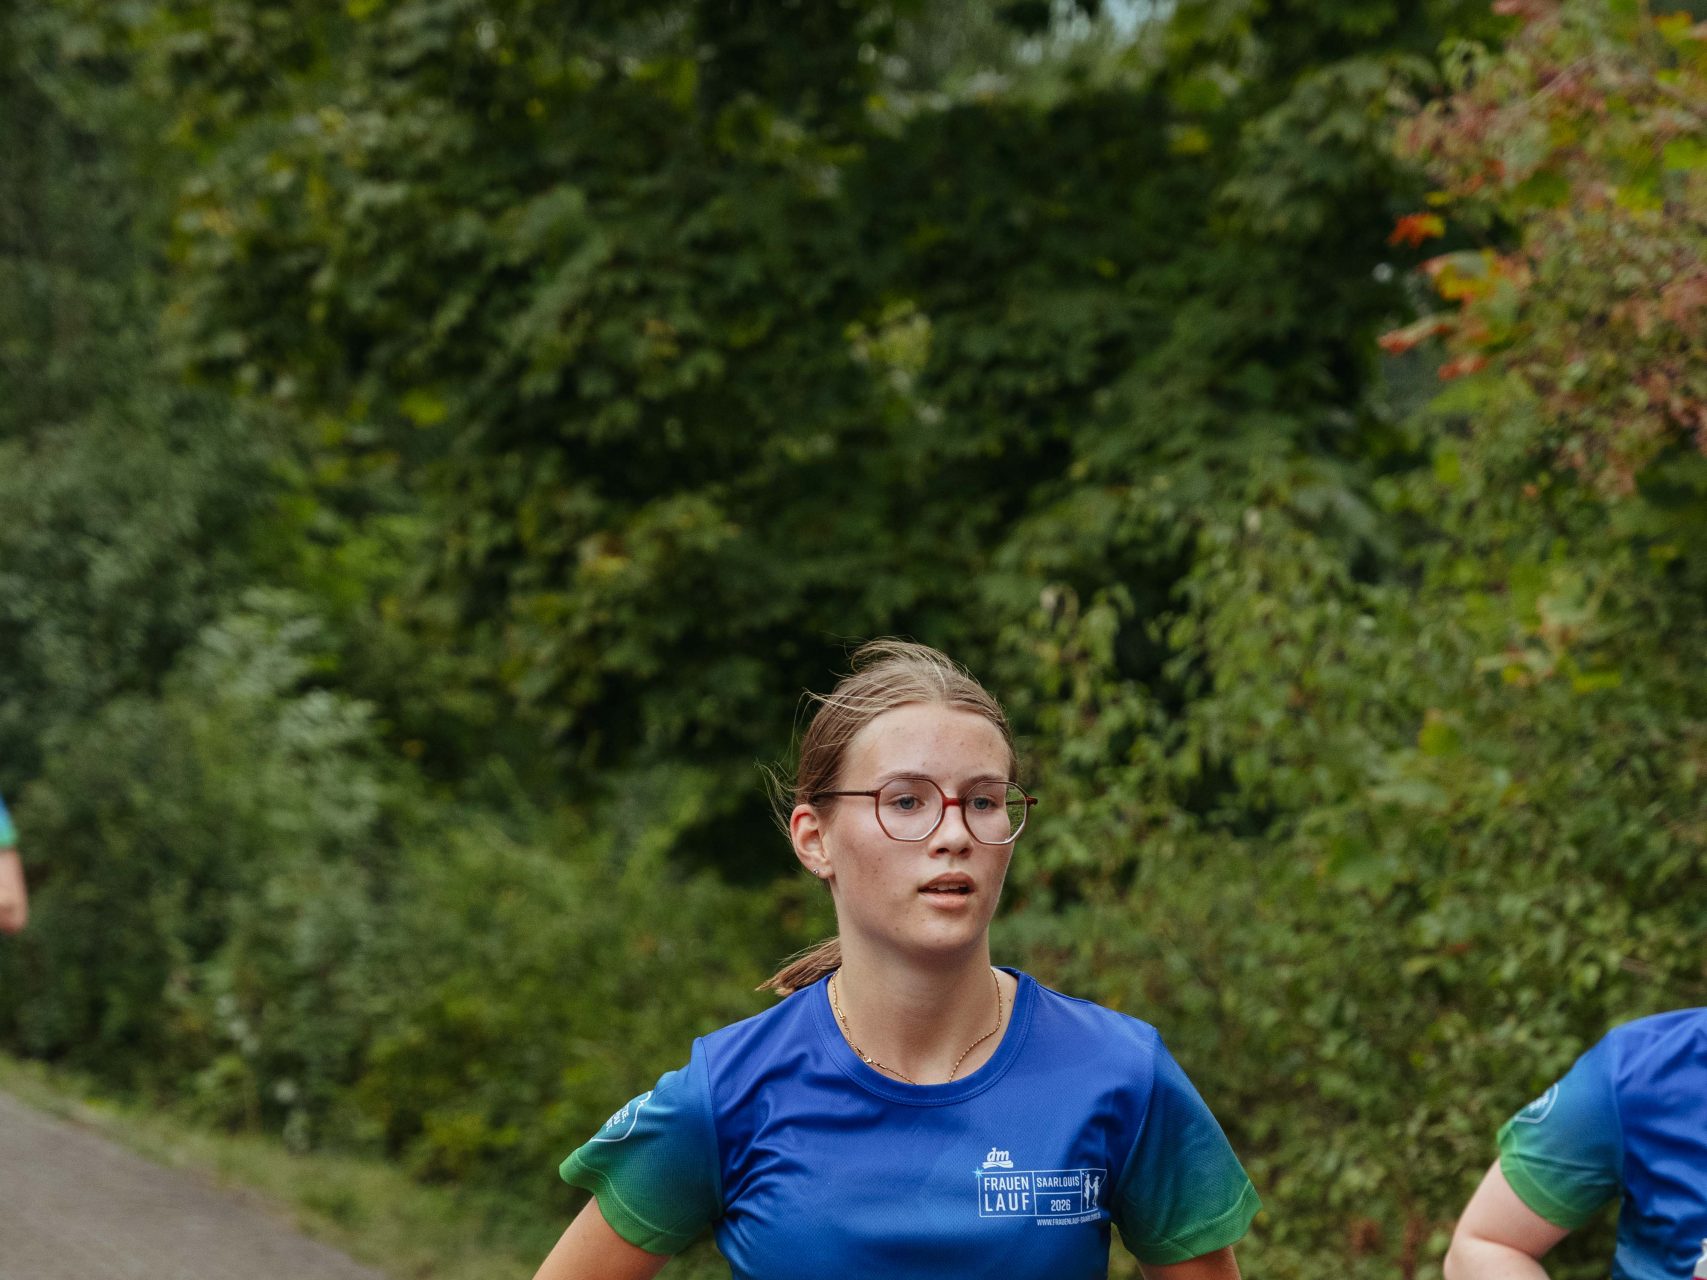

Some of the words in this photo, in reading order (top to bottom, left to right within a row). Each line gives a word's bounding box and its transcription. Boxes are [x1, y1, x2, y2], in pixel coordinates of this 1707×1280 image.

[987, 1147, 1010, 1162] dm
[984, 1176, 1030, 1192] FRAUEN
[1036, 1175, 1080, 1188] SAARLOUIS
[984, 1192, 1030, 1212] LAUF
[1050, 1198, 1072, 1212] 2026
